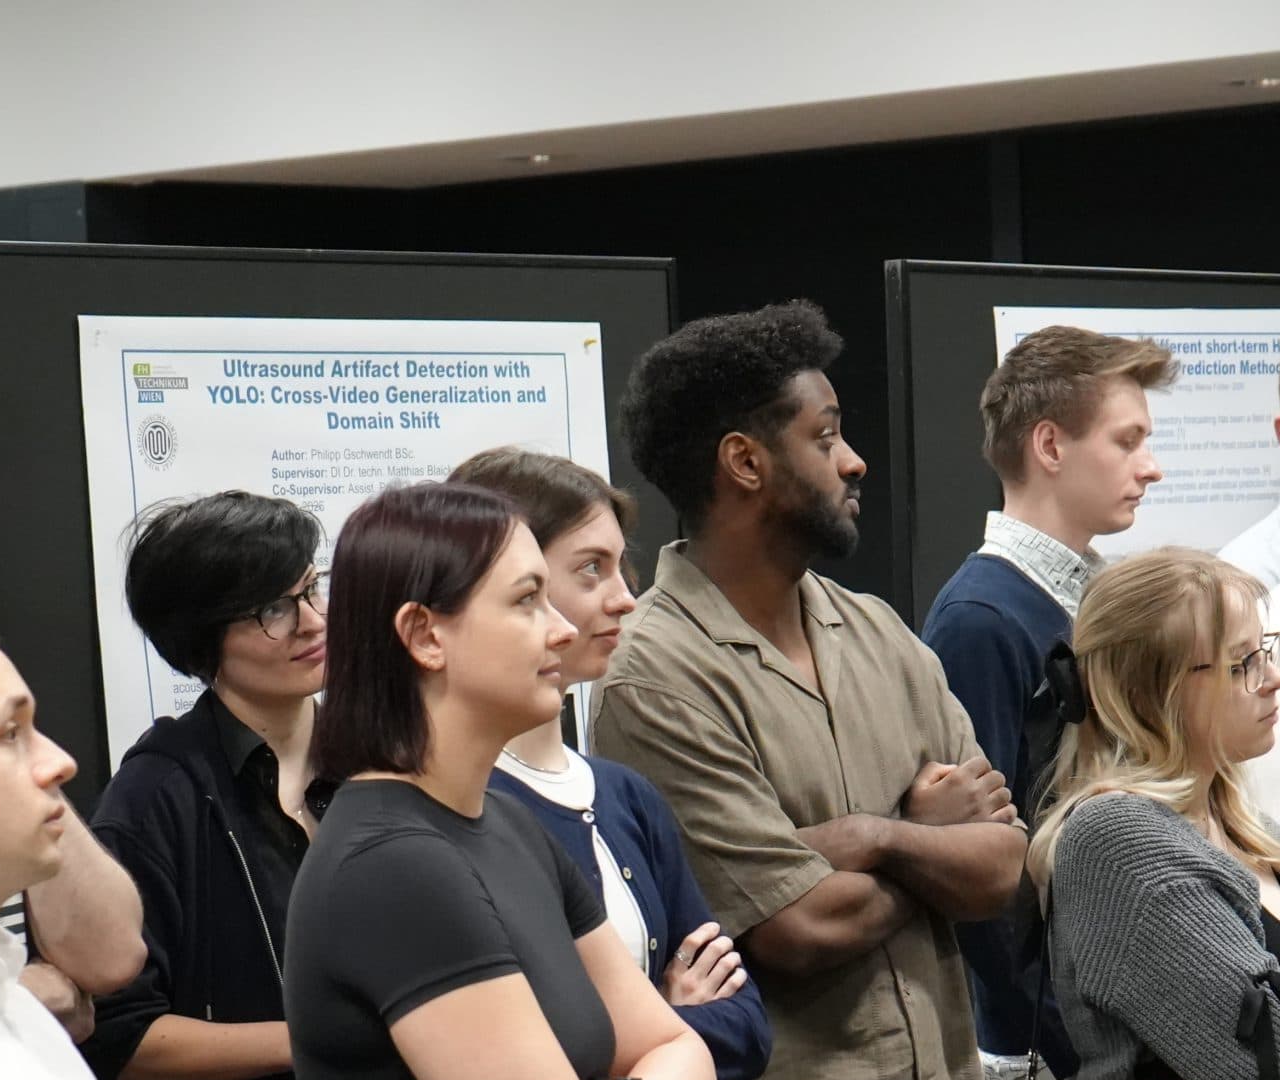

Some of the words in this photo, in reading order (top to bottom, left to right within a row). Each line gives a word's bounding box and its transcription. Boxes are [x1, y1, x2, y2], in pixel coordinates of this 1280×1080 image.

[1206, 338, 1267, 355] short-term
[137, 365, 149, 375] FH
[223, 359, 324, 378] Ultrasound
[331, 359, 400, 378] Artifact
[406, 360, 488, 378] Detection
[494, 360, 531, 378] with
[138, 378, 186, 389] TECHNIKUM
[140, 392, 162, 402] WIEN
[207, 385, 265, 404] YOLO:
[271, 385, 380, 404] Cross-Video
[386, 385, 511, 404] Generalization
[517, 386, 546, 403] and
[327, 411, 394, 430] Domain
[400, 411, 440, 429] Shift
[272, 449, 308, 461] Author:
[311, 449, 341, 464] Philipp
[343, 448, 392, 460] Gschwendt
[395, 448, 416, 460] BSc.
[272, 467, 328, 481] Supervisor:
[331, 467, 341, 479] DI
[344, 467, 355, 478] Dr.
[358, 466, 384, 478] techn.
[388, 465, 424, 478] Matthias
[272, 484, 345, 497] Co-Supervisor:
